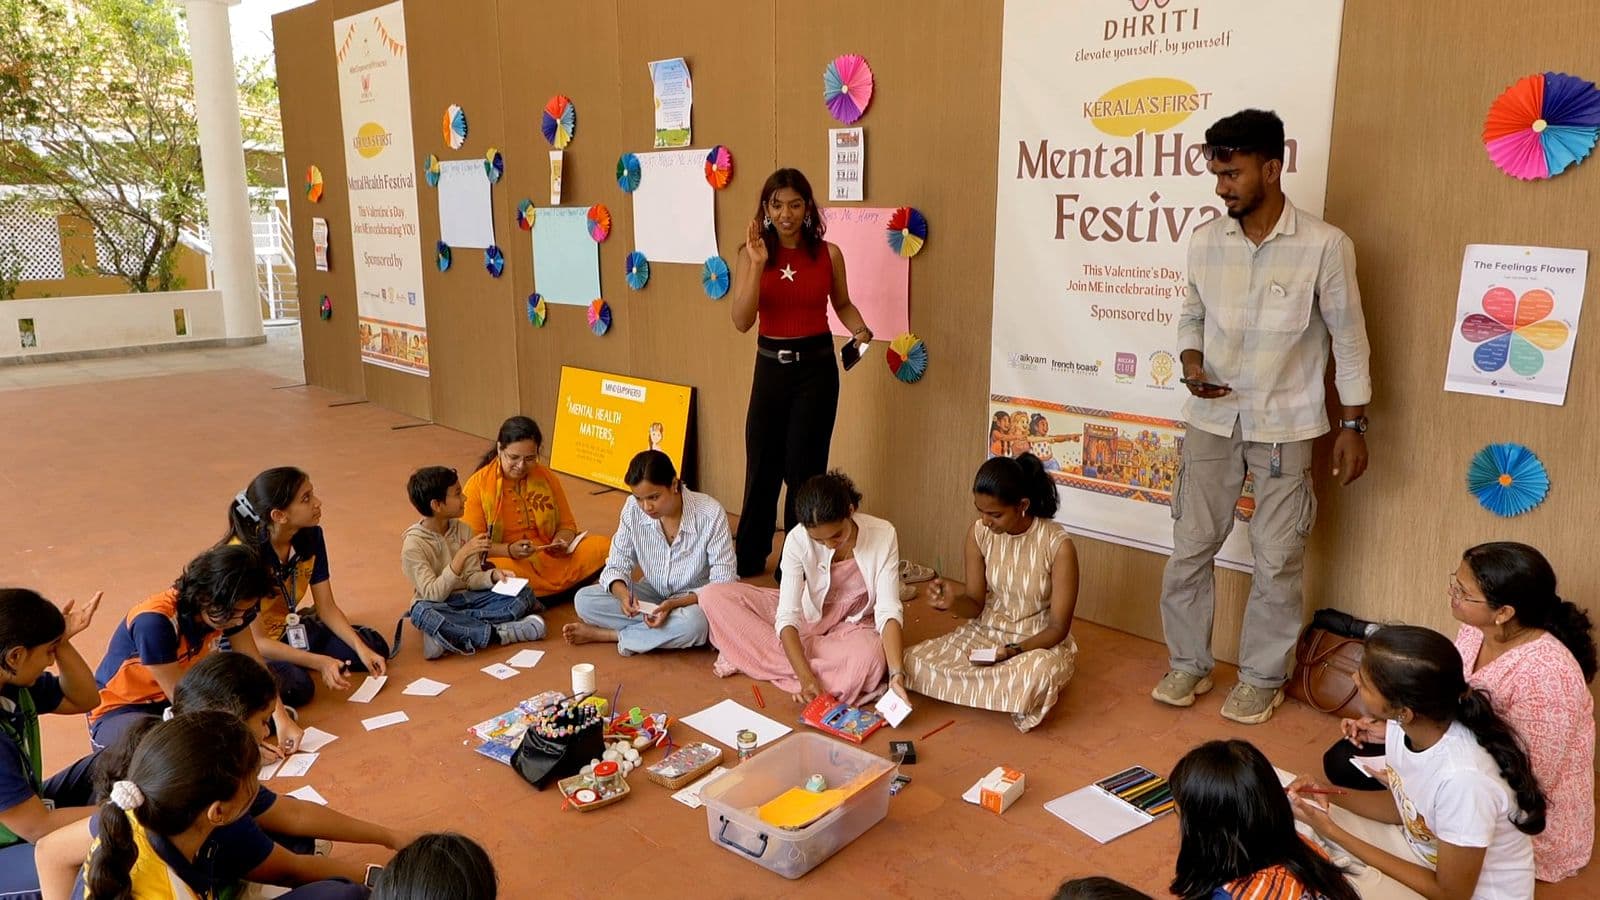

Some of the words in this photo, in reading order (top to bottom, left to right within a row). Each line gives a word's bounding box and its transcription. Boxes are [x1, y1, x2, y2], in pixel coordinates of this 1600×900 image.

[1103, 8, 1199, 41] DHRITI
[1075, 49, 1112, 62] Elevate
[1165, 38, 1179, 54] by
[1181, 30, 1233, 54] yourself
[1083, 96, 1159, 119] KERALA'S
[1162, 92, 1213, 113] FIRST
[1016, 131, 1144, 179] Mental
[384, 172, 414, 190] Festival
[402, 223, 416, 236] YOU
[1083, 263, 1103, 276] This
[1104, 265, 1159, 279] Valentine's
[1474, 260, 1493, 270] The
[1495, 262, 1538, 273] Feelings
[1540, 264, 1576, 274] Flower
[1066, 280, 1087, 292] Join
[1088, 281, 1104, 293] ME
[1105, 281, 1114, 293] in
[1115, 283, 1172, 299] celebrating
[1090, 304, 1155, 322] Sponsored
[1157, 308, 1173, 326] by
[1020, 353, 1047, 364] aikyam
[595, 408, 622, 425] HEALTH
